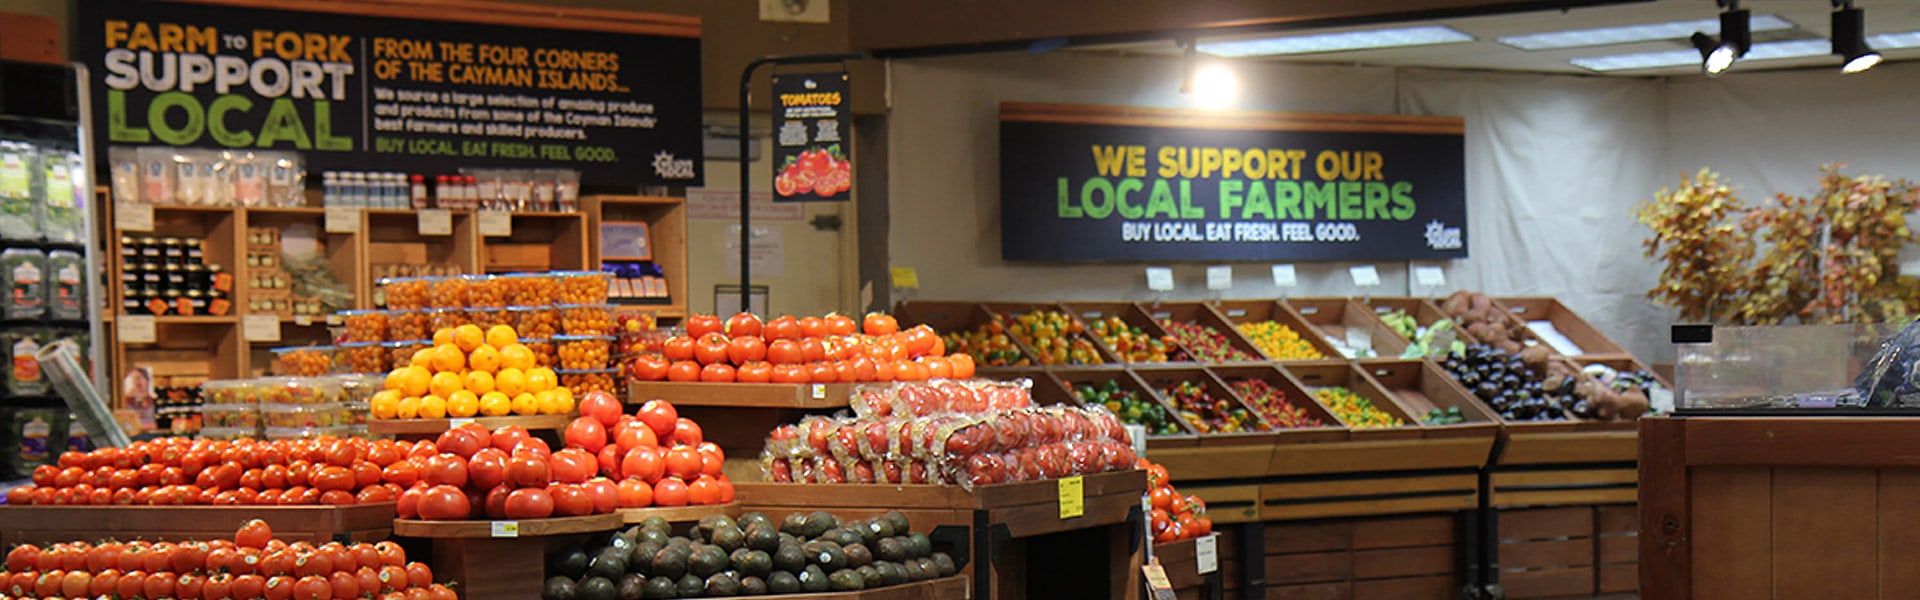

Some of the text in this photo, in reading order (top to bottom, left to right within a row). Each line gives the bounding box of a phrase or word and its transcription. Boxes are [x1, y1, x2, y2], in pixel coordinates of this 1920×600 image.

[105, 20, 352, 62] FARM TO FORK
[373, 37, 619, 72] FROM THE FOUR CORNERS
[104, 48, 354, 100] SUPPORT
[374, 58, 402, 80] OF
[409, 61, 443, 83] THE
[449, 63, 533, 87] CAYMAN
[374, 87, 654, 115] We source a large selection of amazing produce
[780, 92, 842, 107] TOMATOES
[107, 88, 353, 150] LOCAL
[374, 102, 399, 116] and
[400, 104, 457, 119] products
[458, 107, 491, 120] from
[492, 109, 525, 122] some
[526, 110, 541, 123] of
[543, 111, 564, 124] the
[565, 112, 613, 127] Cayman
[374, 117, 588, 140] best farmers and skilled producers.
[375, 137, 619, 162] BUY LOCAL. EAT FRESH. FEEL GOOD.
[1091, 145, 1385, 181] WE SUPPORT OUR
[1057, 176, 1417, 221] LOCAL FARMERS
[1122, 221, 1361, 242] BUY LOCAL. EAT FRESH. FEEL GOOD.
